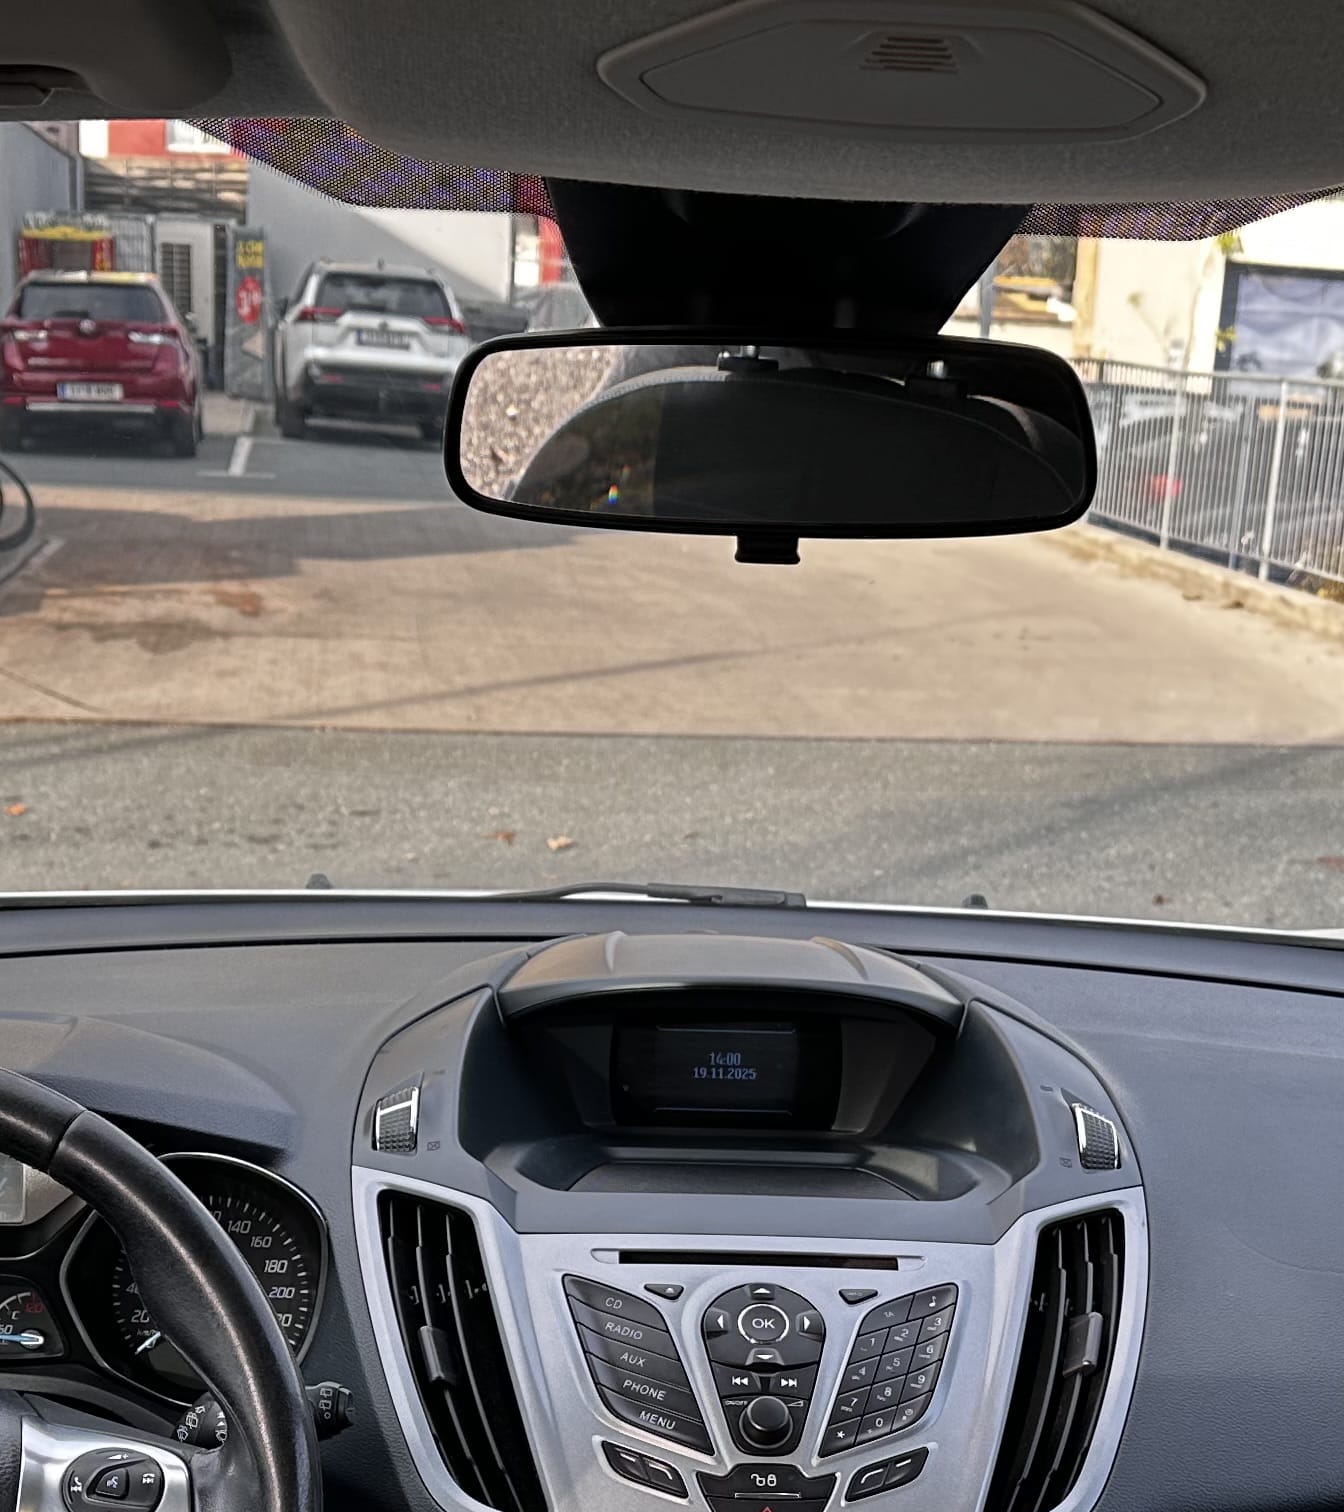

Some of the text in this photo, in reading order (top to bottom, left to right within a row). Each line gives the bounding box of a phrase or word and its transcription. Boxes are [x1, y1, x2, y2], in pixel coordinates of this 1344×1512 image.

[693, 1066, 757, 1080] 19.11.2025
[228, 1220, 252, 1234] 140
[250, 1236, 272, 1249] 160
[264, 1260, 288, 1274] 180
[269, 1286, 295, 1299] 200
[605, 1297, 623, 1309] CD
[131, 1309, 150, 1323] 20
[934, 1317, 943, 1326] 3
[752, 1318, 776, 1329] OK
[604, 1321, 644, 1340] RADIO
[900, 1328, 910, 1338] 2
[926, 1344, 935, 1355] 6
[620, 1352, 647, 1368] AUX
[892, 1357, 901, 1368] 5
[858, 1365, 867, 1376] 4
[917, 1374, 927, 1384] 9
[622, 1379, 667, 1401] PHONE
[883, 1386, 893, 1398] 8
[850, 1396, 859, 1407] 7
[639, 1410, 677, 1430] MENU
[875, 1417, 885, 1428] 0
